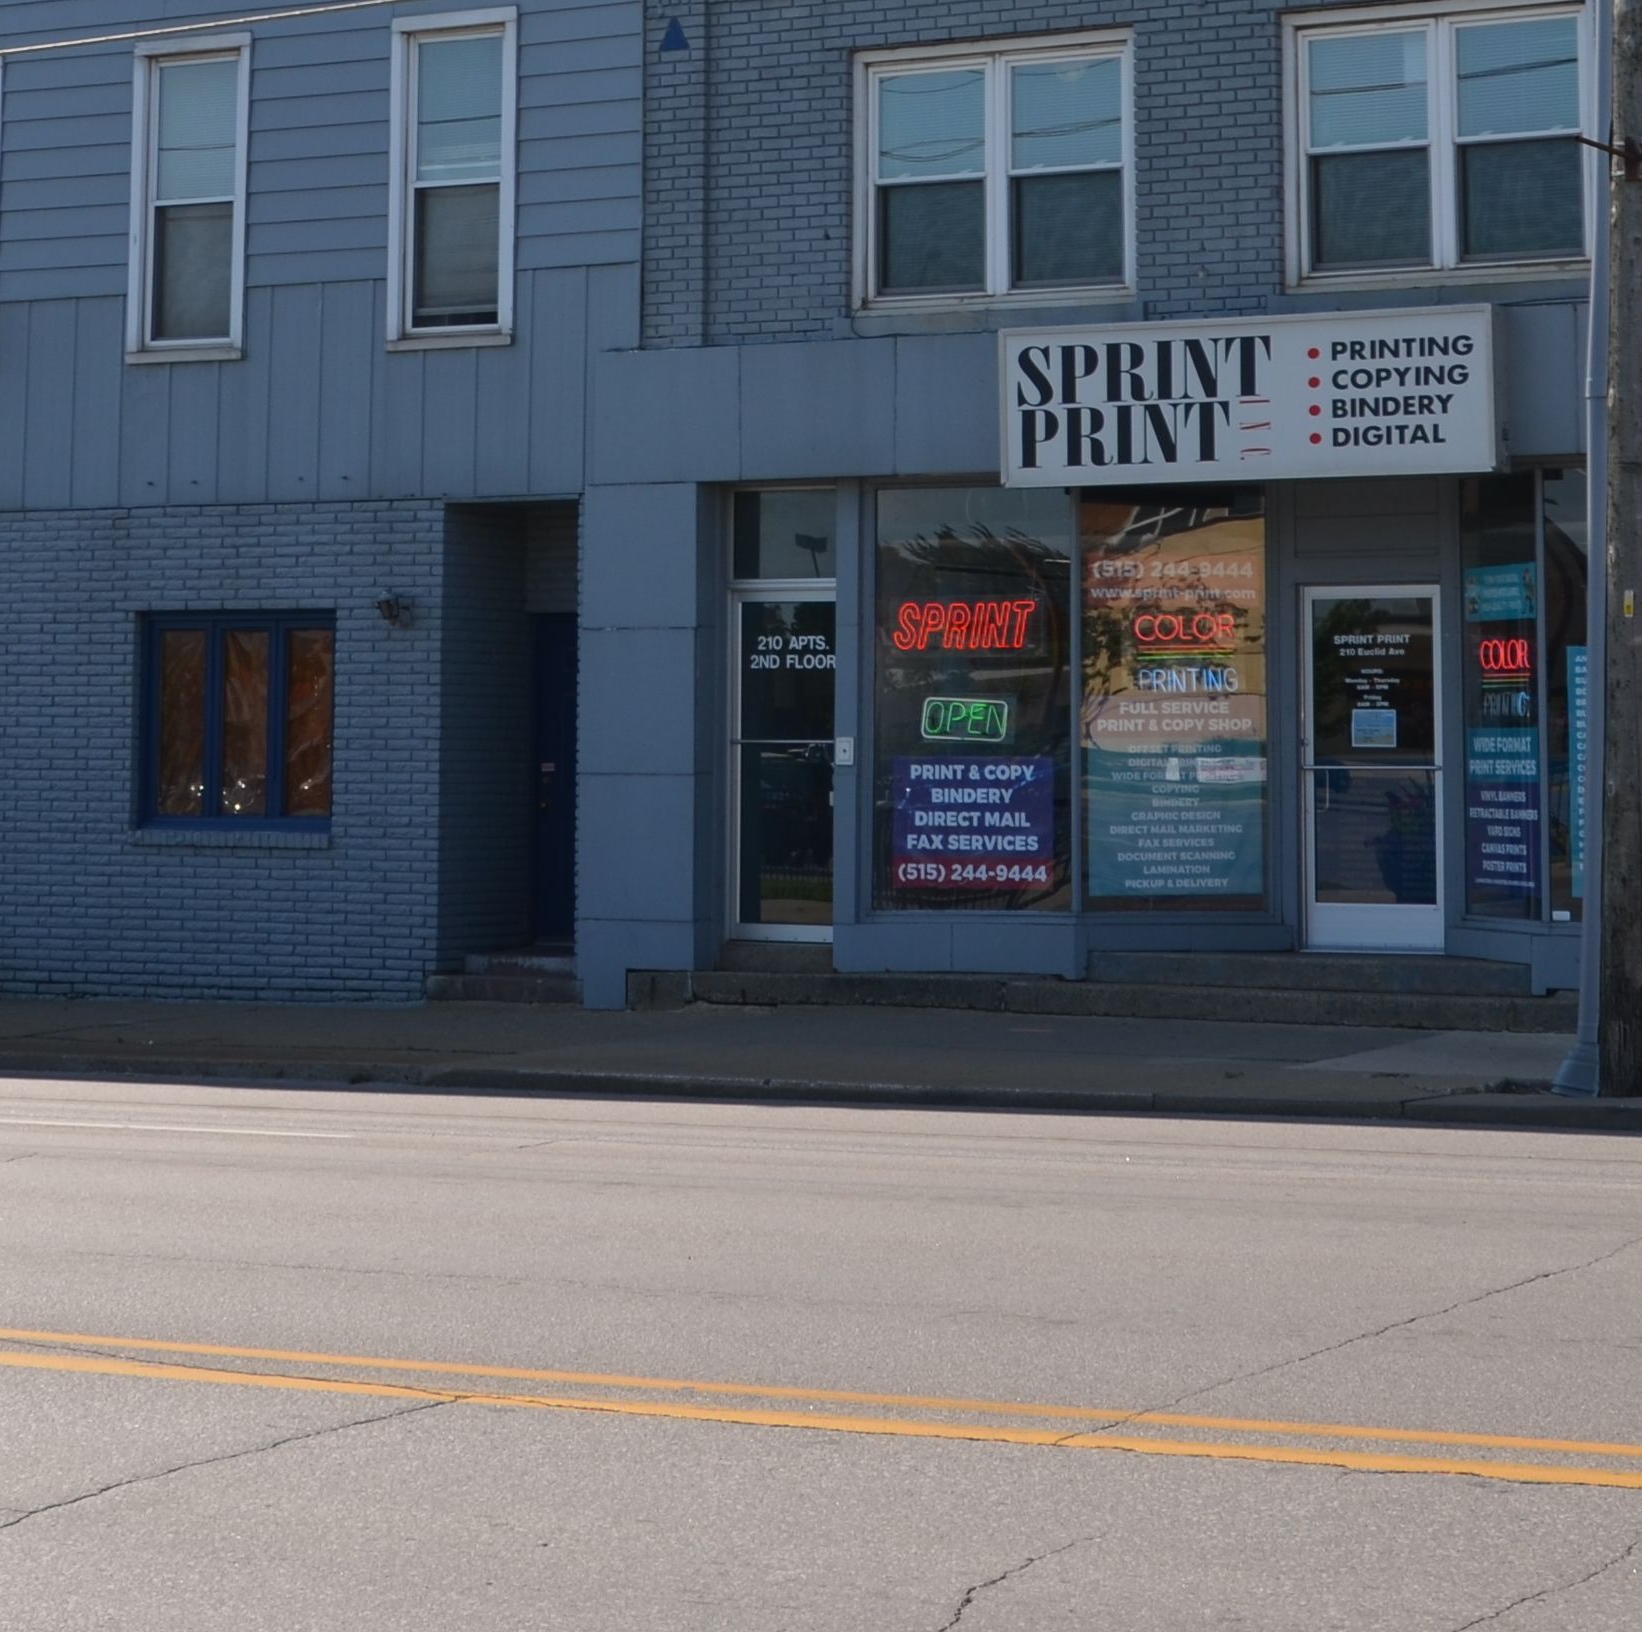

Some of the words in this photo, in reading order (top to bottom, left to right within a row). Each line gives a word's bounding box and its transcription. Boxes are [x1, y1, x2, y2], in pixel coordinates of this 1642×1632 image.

[1331, 335, 1474, 361] PRINTING
[1017, 335, 1271, 407] SPRINT
[1331, 364, 1469, 390] COPYING
[1331, 394, 1455, 419] BINDERY
[1017, 401, 1231, 469] PRINT
[1332, 423, 1446, 447] DIGITAL
[1092, 559, 1145, 579] (515)
[1151, 561, 1254, 578] 244-9444
[1091, 587, 1256, 600] www.sprint-print.com
[893, 599, 1036, 651] SPRINT
[1134, 611, 1236, 641] COLOR
[757, 636, 783, 650] 210
[789, 635, 830, 650] APTS.
[1333, 635, 1374, 645] SPRINT
[1377, 634, 1411, 644] PRINT
[1339, 648, 1356, 656] 210
[1358, 648, 1386, 656] Euclid
[1480, 639, 1531, 670] COLOR
[750, 654, 780, 669] 2ND
[786, 654, 837, 669] FLOOR
[1138, 667, 1239, 693] PRINTING
[1119, 702, 1157, 714] FULL
[1161, 701, 1230, 714] SERVICE
[925, 701, 1006, 735] OPEN
[1097, 719, 1146, 732] PRINT
[1149, 719, 1159, 732] &
[1162, 719, 1205, 732] COPY
[1208, 718, 1252, 731] SHOP
[1128, 744, 1169, 754] OFFSET
[1171, 744, 1222, 753] PRINTING
[1473, 737, 1496, 753] WIDE
[1497, 737, 1532, 753] FORMAT
[910, 764, 965, 780] PRINT
[968, 764, 980, 780] &
[984, 764, 1035, 781] COPY
[1469, 759, 1494, 775] PRINT
[1495, 759, 1536, 776] SERVICES
[1111, 771, 1141, 781] WIDE
[1143, 771, 1186, 781] FORAT
[931, 788, 1013, 804] BINDERY
[1151, 784, 1200, 794] COPYING
[1480, 790, 1498, 802] VINYL
[1498, 790, 1526, 803] BANNERS
[1152, 798, 1200, 807] BINDERY
[914, 811, 981, 827] DIRECT
[984, 812, 1031, 827] MAIL
[1131, 811, 1178, 821] GRAPHIC
[1181, 811, 1221, 821] DESIGN
[1469, 807, 1510, 820] RETRACTABLE
[1510, 809, 1538, 821] BANNERS
[1110, 825, 1148, 834] DIRECT
[1150, 825, 1177, 834] MAIL
[1179, 824, 1243, 834] MARKETING
[907, 834, 943, 850] FAX
[947, 835, 1039, 851] SERVICES
[1138, 838, 1160, 847] FAX
[1162, 838, 1215, 847] SERVICES
[1481, 842, 1506, 855] CANVAS
[1506, 843, 1527, 856] PRINTS
[1117, 852, 1177, 861] DOCUMENT
[1180, 851, 1236, 860] SCANNING
[898, 863, 946, 882] (515)
[951, 864, 1047, 882] 244-9444
[1143, 865, 1210, 874] LAMINATION
[1483, 860, 1506, 872] POSTER
[1506, 861, 1527, 874] PRINTS
[1125, 879, 1165, 888] PICKUP
[1176, 878, 1228, 888] DELIVERY
